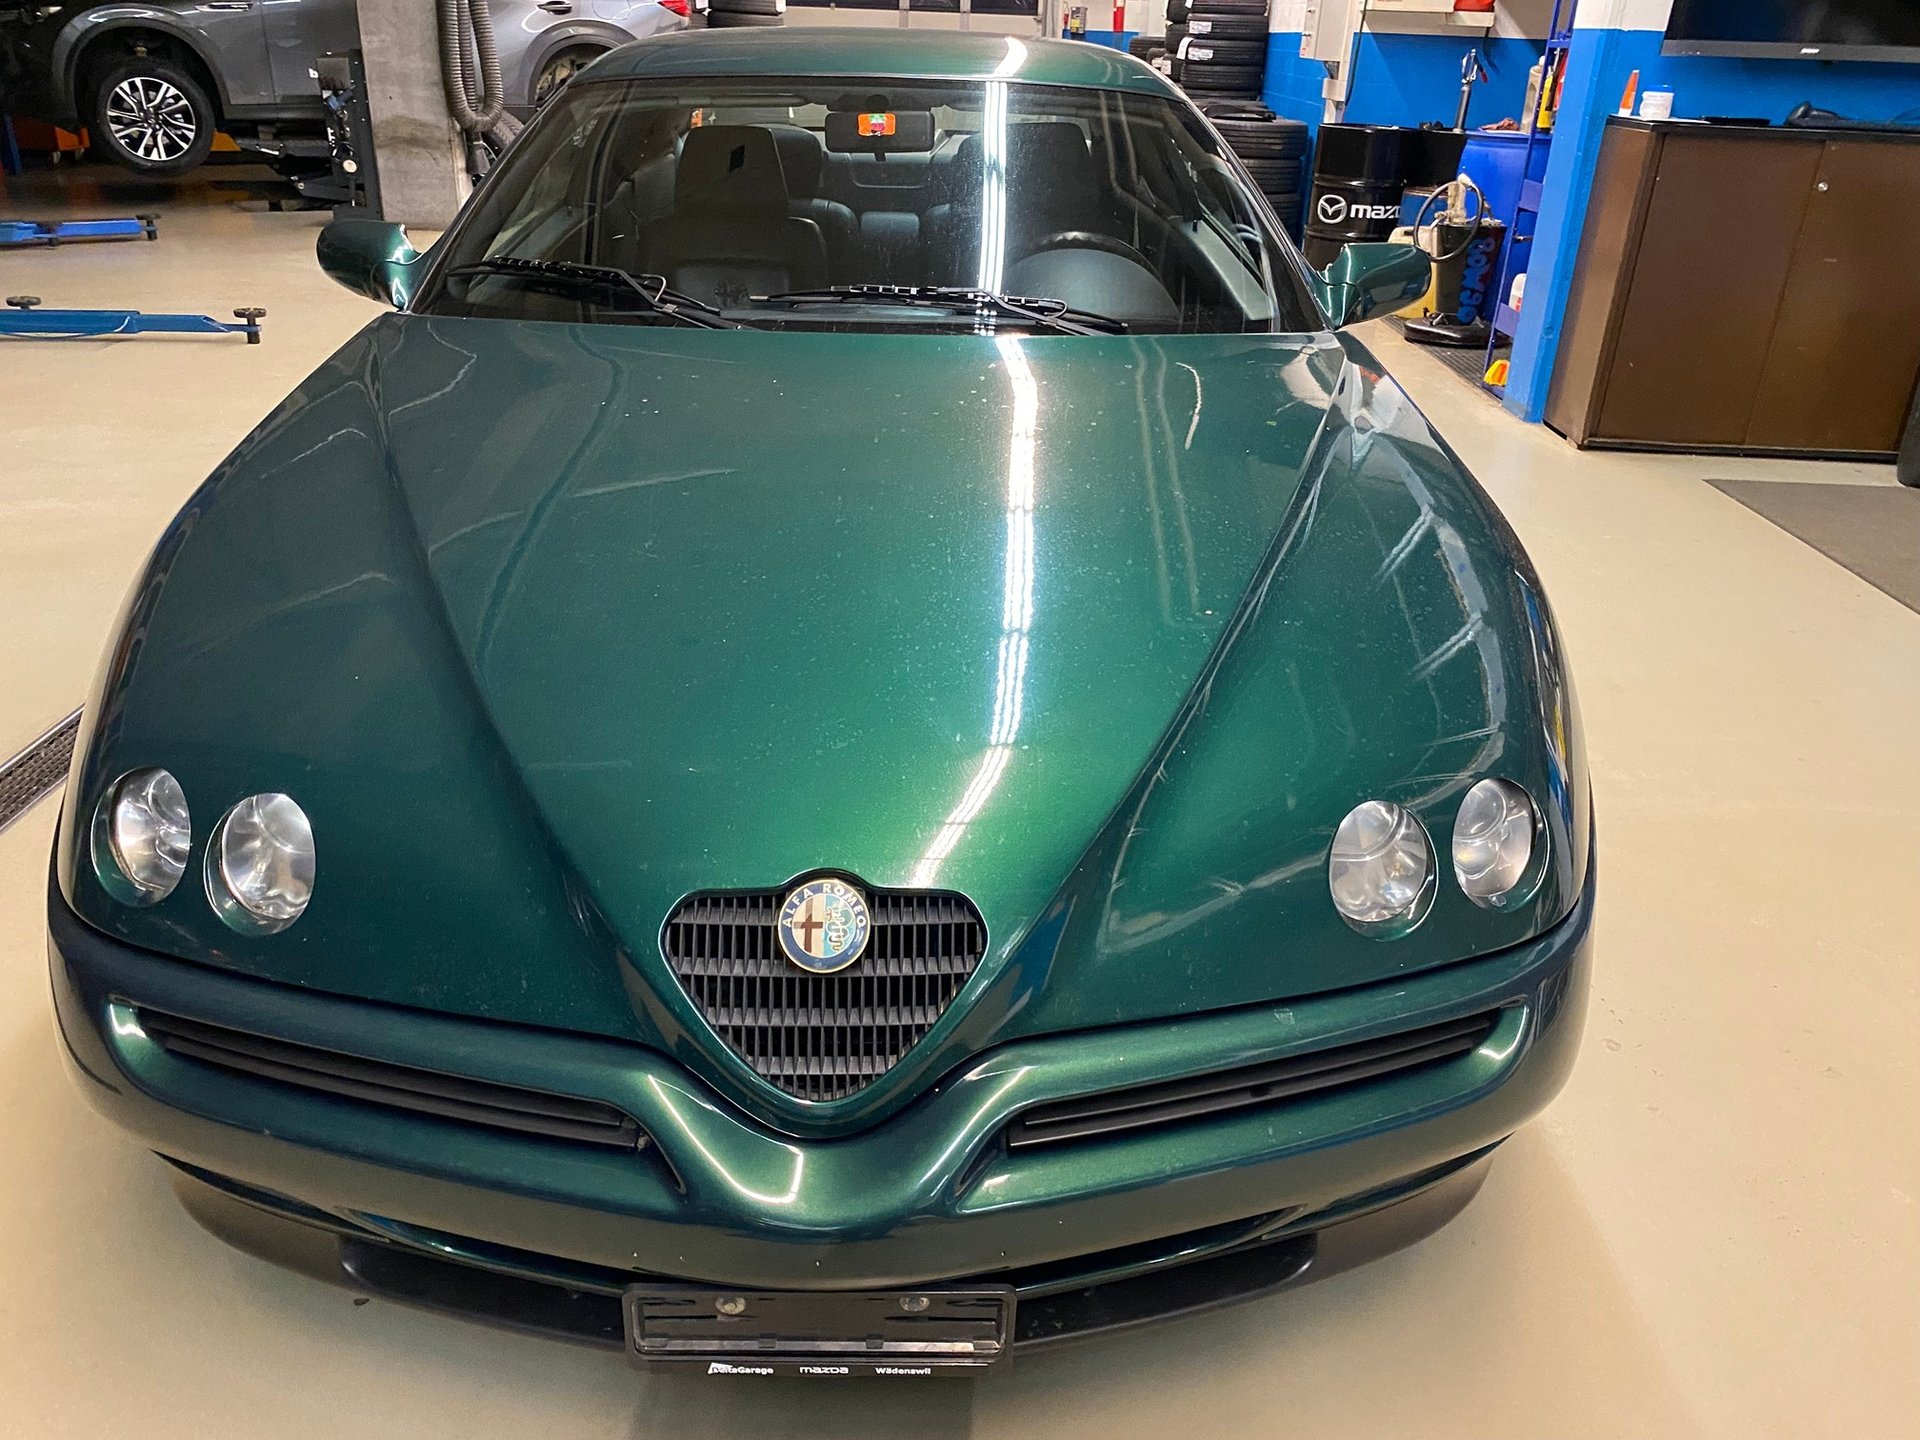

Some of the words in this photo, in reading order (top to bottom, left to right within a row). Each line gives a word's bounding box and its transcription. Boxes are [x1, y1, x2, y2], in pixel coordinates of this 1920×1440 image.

[782, 888, 814, 928] ALFA
[822, 883, 867, 928] ROMEO
[799, 1366, 849, 1374] mazda
[875, 1366, 931, 1375] Wädenswil
